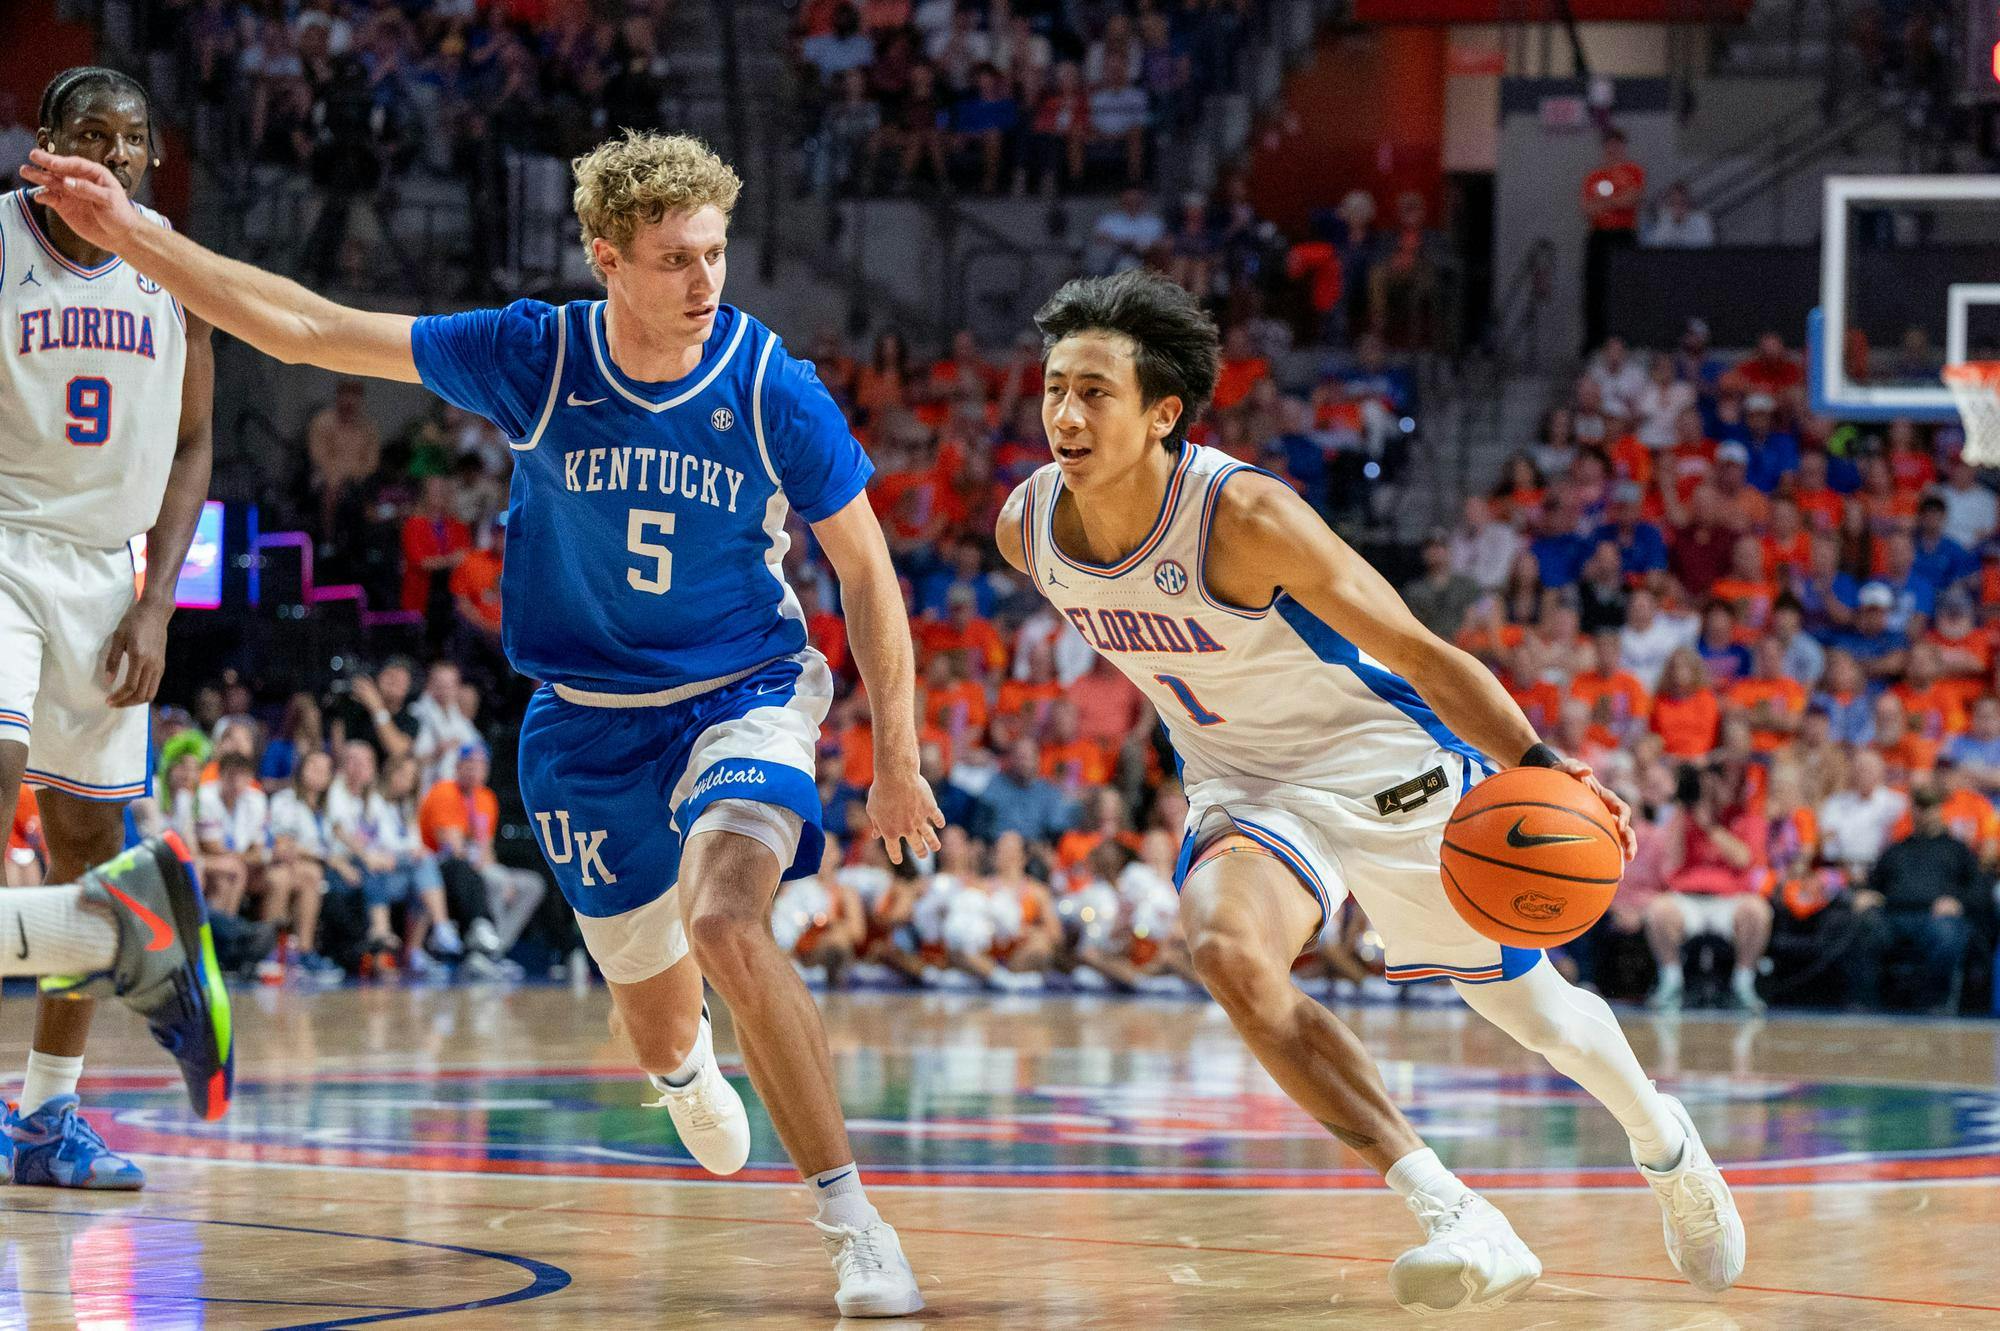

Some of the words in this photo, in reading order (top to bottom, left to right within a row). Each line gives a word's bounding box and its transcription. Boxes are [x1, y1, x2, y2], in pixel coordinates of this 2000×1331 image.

[19, 306, 156, 360] FLORIDA
[66, 375, 112, 446] 9
[713, 409, 731, 430] SEC
[565, 447, 744, 513] KENTUCKY
[627, 508, 676, 595] 5
[1155, 561, 1187, 594] SEC
[1064, 607, 1228, 653] FLORIDA
[1154, 674, 1228, 727] 1
[688, 766, 766, 805] Wildcats
[1427, 776, 1439, 789] 46
[535, 810, 617, 886] UK
